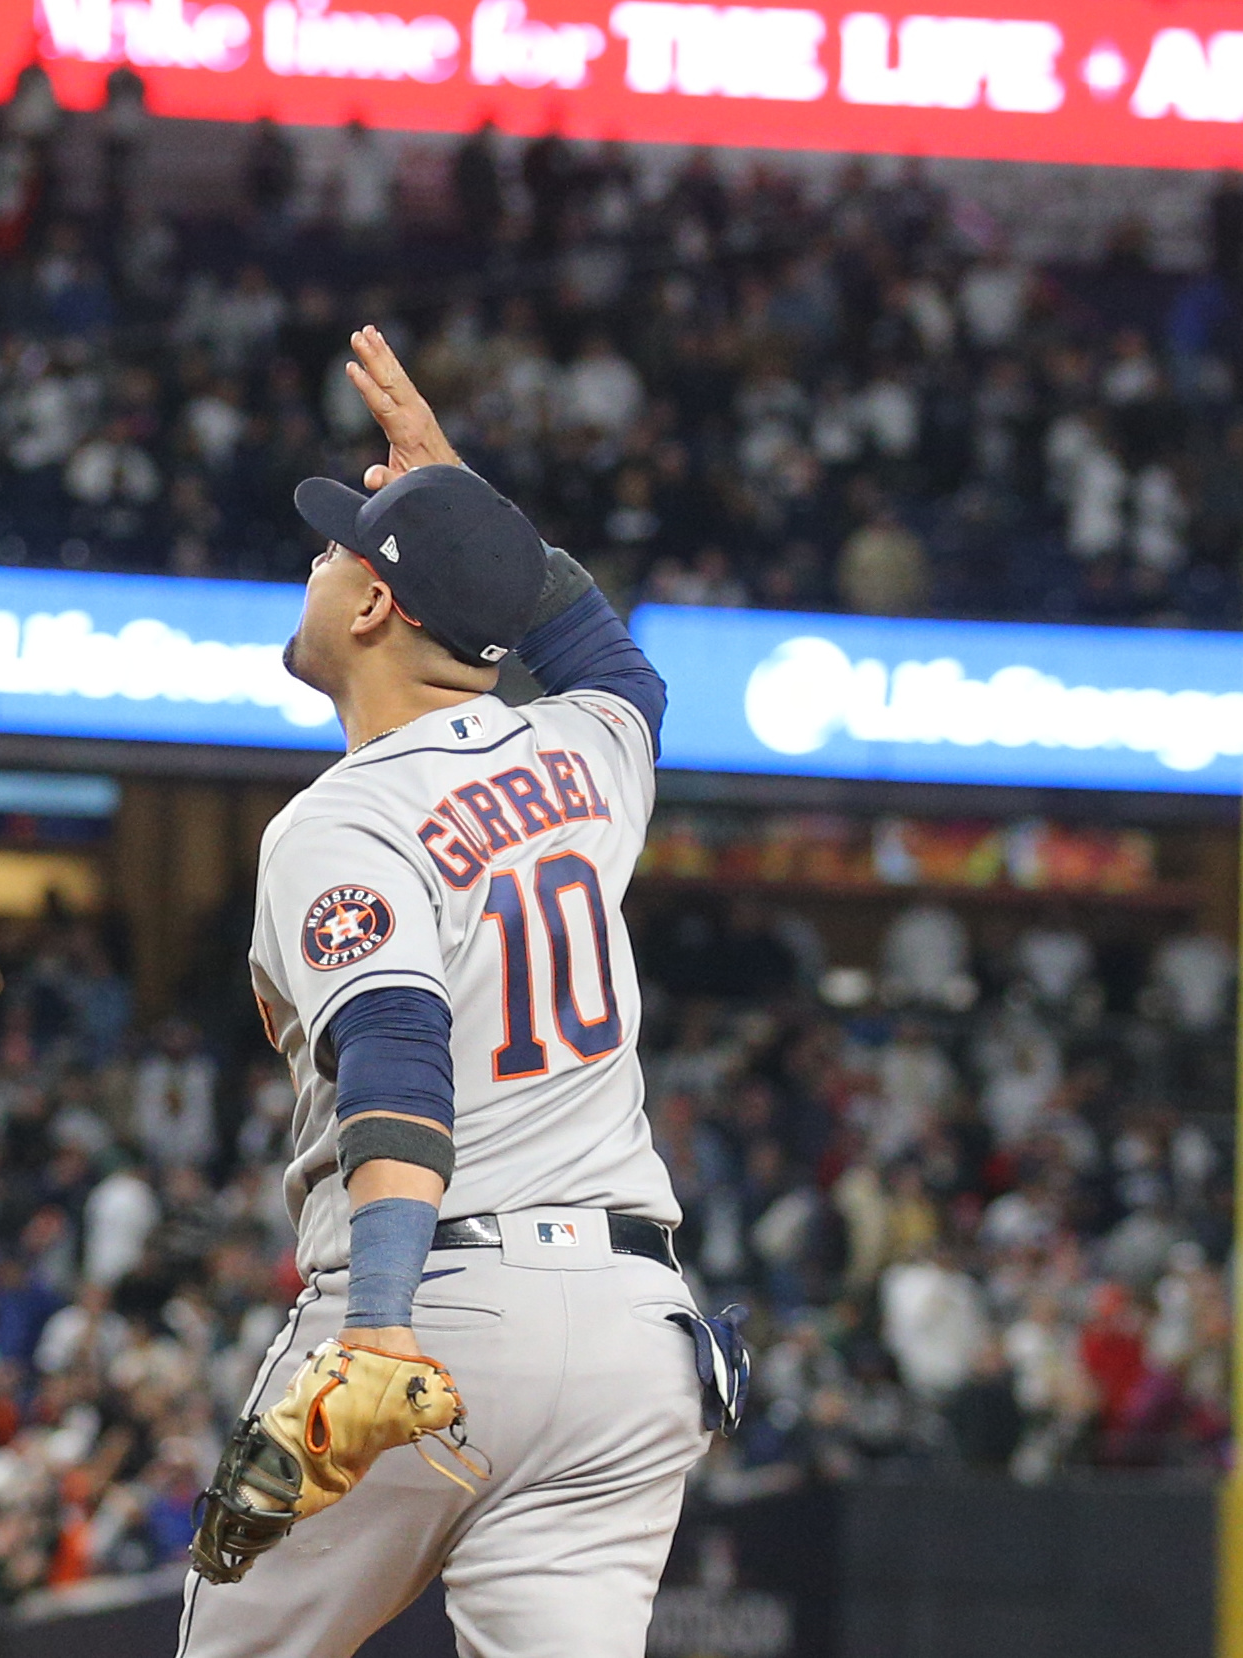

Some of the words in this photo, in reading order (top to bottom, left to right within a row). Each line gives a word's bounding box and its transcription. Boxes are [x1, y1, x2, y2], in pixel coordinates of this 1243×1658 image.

[263, 0, 460, 82] time
[470, 0, 605, 88] for
[609, 1, 827, 101] THE
[839, 11, 1063, 113] LIFE
[307, 889, 376, 927] HOUSTON
[319, 933, 382, 964] ASTROS
[482, 849, 622, 1082] 10
